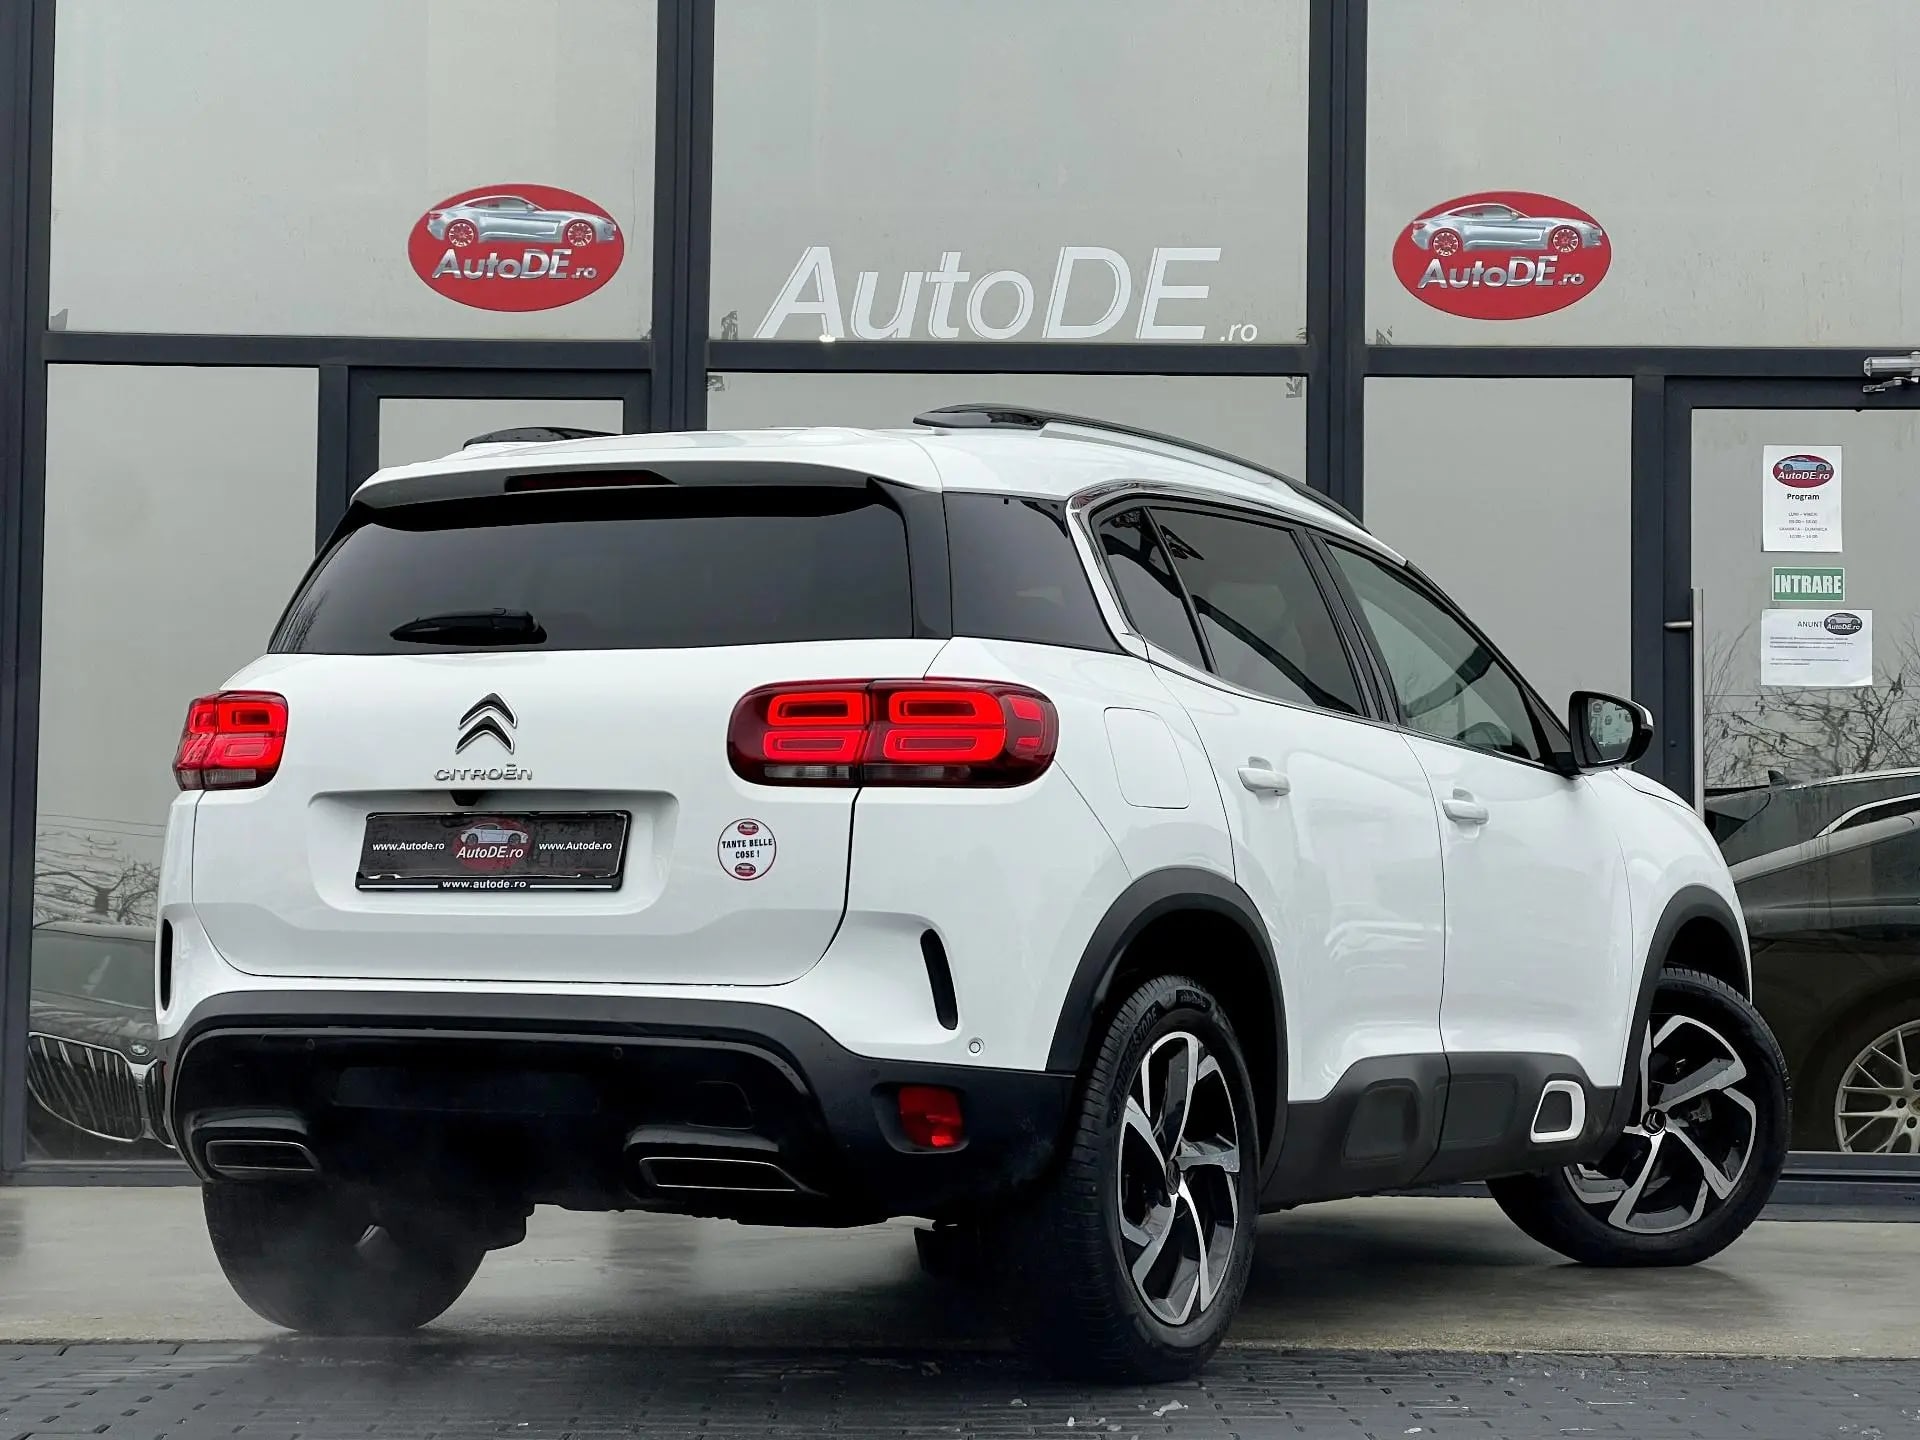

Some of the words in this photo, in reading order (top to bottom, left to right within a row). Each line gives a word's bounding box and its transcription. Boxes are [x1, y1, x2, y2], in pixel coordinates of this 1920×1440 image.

[1777, 470, 1830, 480] AutoDE.ro
[1786, 493, 1820, 502] Program
[1774, 574, 1842, 594] INTRARE
[372, 841, 445, 851] www.Autode.ro
[538, 840, 613, 851] www.Autode.ro
[721, 839, 747, 849] TANTE
[749, 838, 773, 847] BELLE
[456, 845, 524, 859] AutoDE.ro
[735, 849, 755, 859] COSE
[442, 879, 527, 889] www.autode.ro
